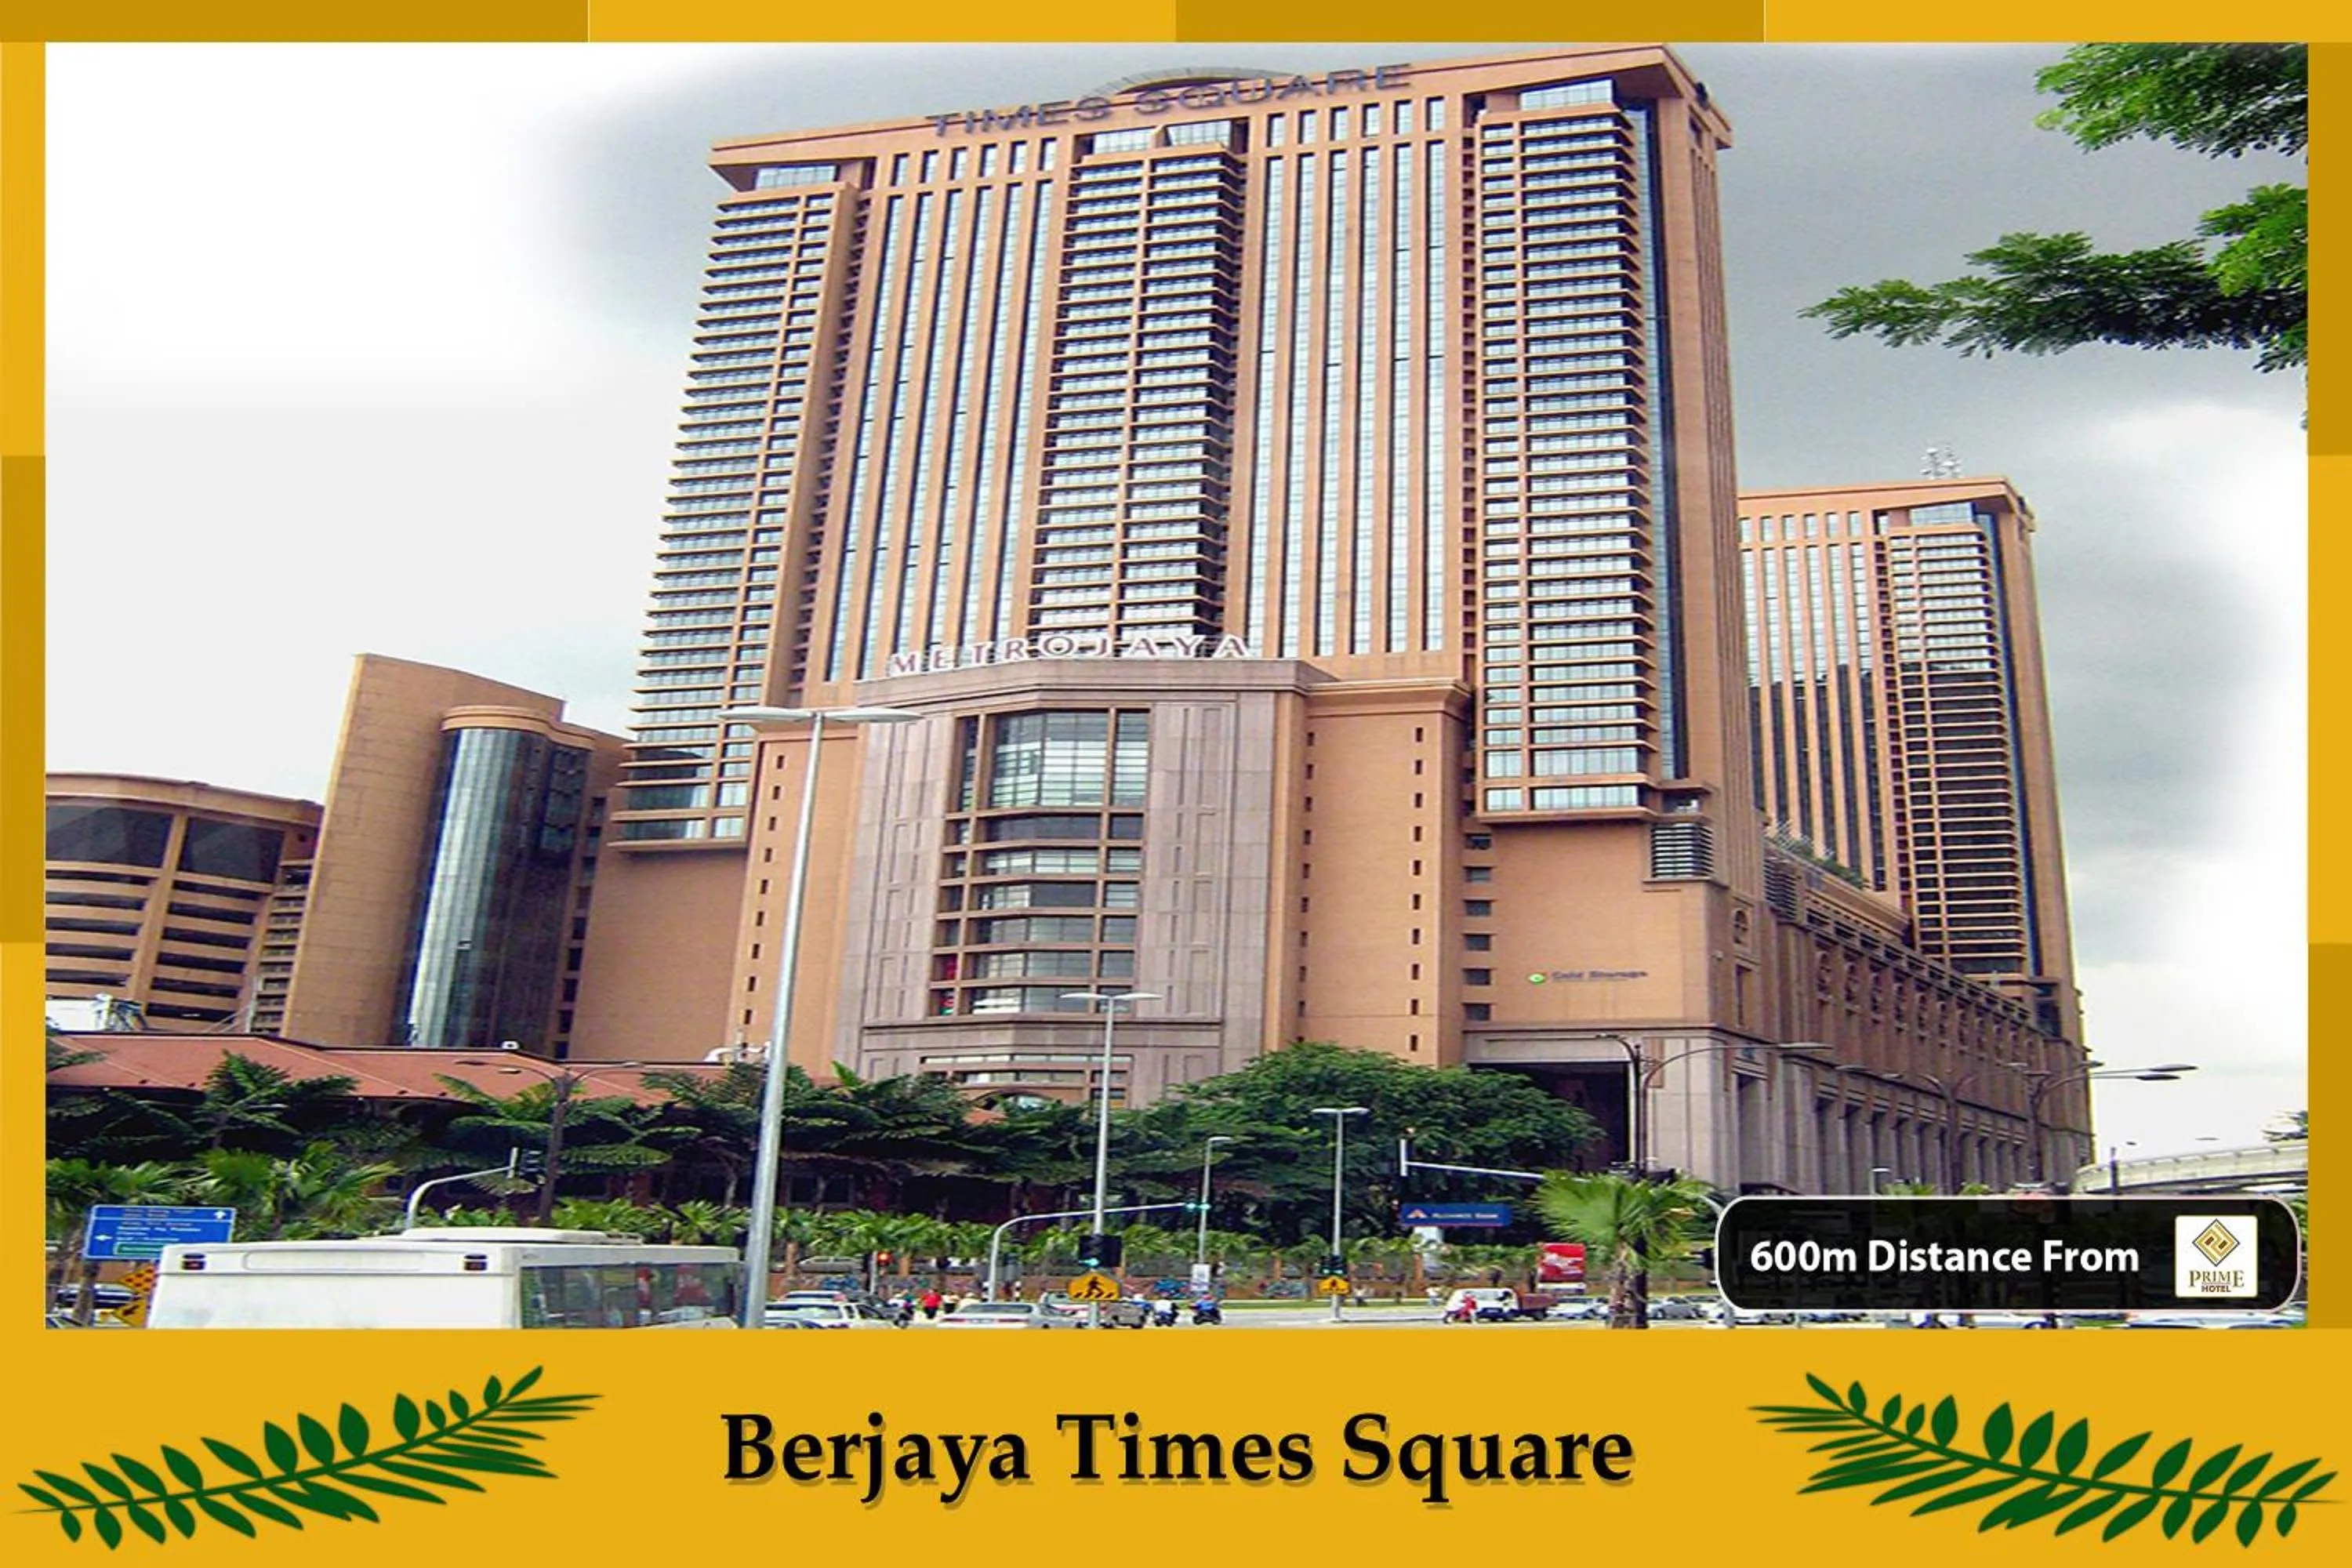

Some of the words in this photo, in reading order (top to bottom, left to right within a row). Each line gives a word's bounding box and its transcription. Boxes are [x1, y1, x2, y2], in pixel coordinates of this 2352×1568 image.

[924, 93, 1112, 137] TIMES
[1134, 62, 1414, 117] SQUARE
[889, 633, 1251, 676] METROJAYA
